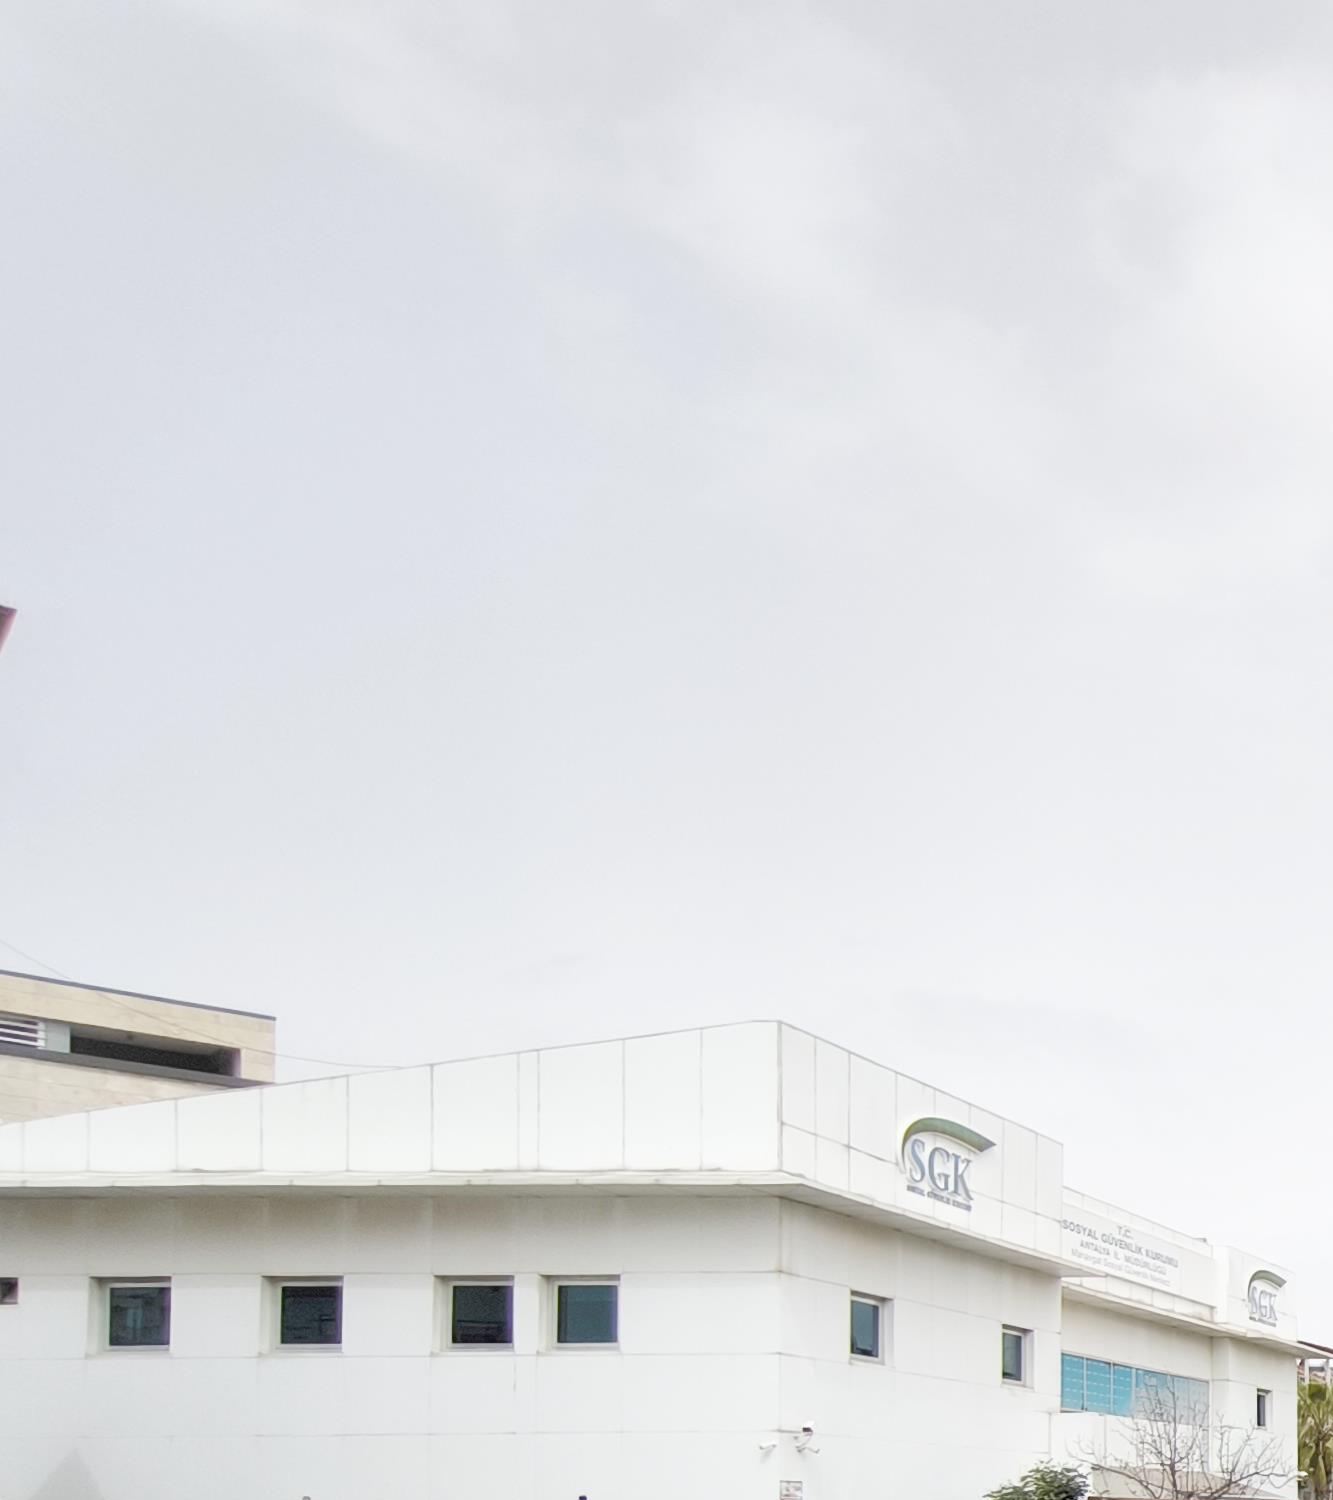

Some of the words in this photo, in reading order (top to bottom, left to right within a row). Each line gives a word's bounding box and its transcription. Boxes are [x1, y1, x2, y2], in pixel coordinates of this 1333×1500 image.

[910, 1139, 974, 1200] SGK
[1061, 1219, 1099, 1241] SOSYAL
[1251, 1286, 1279, 1321] SGK
